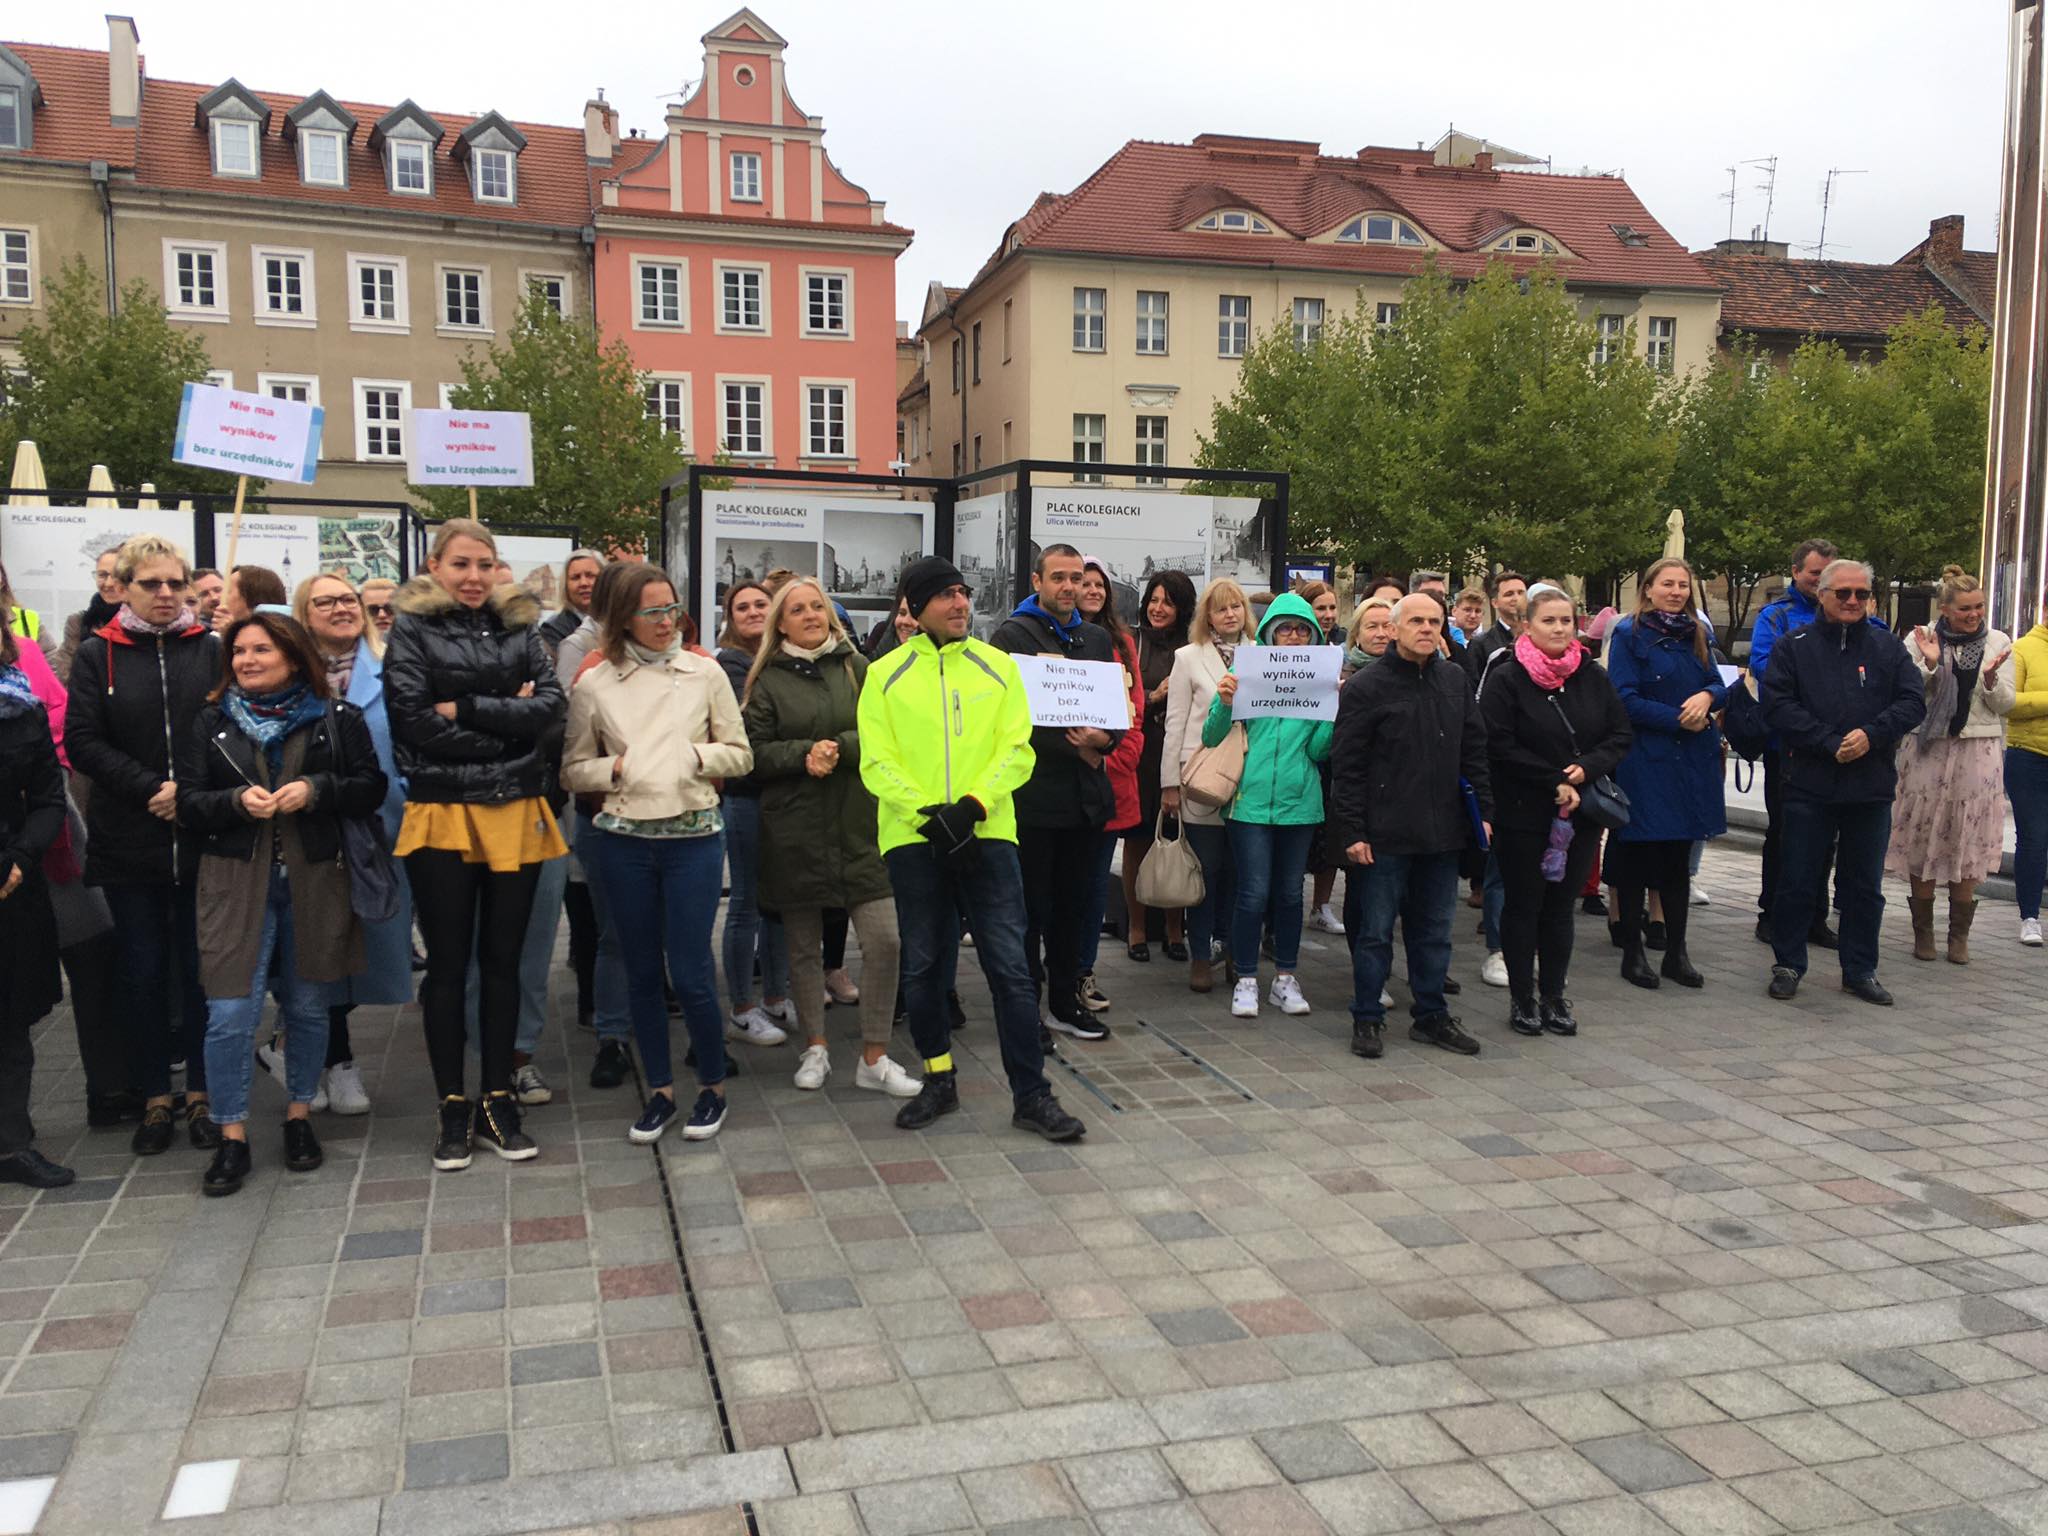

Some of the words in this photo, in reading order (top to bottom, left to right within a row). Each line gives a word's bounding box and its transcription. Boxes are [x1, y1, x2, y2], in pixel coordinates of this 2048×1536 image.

[229, 400, 250, 412] Nie
[254, 407, 275, 417] ma
[448, 419, 469, 429] Nie
[219, 424, 279, 441] wyników
[445, 442, 497, 453] wyników
[193, 443, 216, 456] bez
[219, 448, 295, 470] urzędników
[425, 465, 447, 474] bez
[449, 465, 518, 476] Urzędników
[716, 503, 743, 514] PLAC
[745, 505, 808, 517] KOLEGIACKI
[1047, 502, 1075, 513] PLAC
[1077, 503, 1141, 517] KOLEGIACKI
[12, 514, 33, 523] PLAC
[35, 515, 87, 524] KOLEGIACKI
[1046, 518, 1065, 526] Ulica
[1066, 519, 1099, 528] Wietrzna
[248, 522, 297, 532] KOLEGIACKI
[1269, 652, 1289, 663] Nie
[1293, 654, 1310, 663] ma
[1046, 663, 1066, 674] Nie
[1069, 666, 1087, 676] ma
[1262, 669, 1316, 681] wyników
[1041, 680, 1095, 693] wyników
[1275, 684, 1296, 694] bez
[1058, 697, 1080, 707] bez
[1251, 697, 1321, 709] urzędników
[1036, 711, 1107, 725] urzędników
